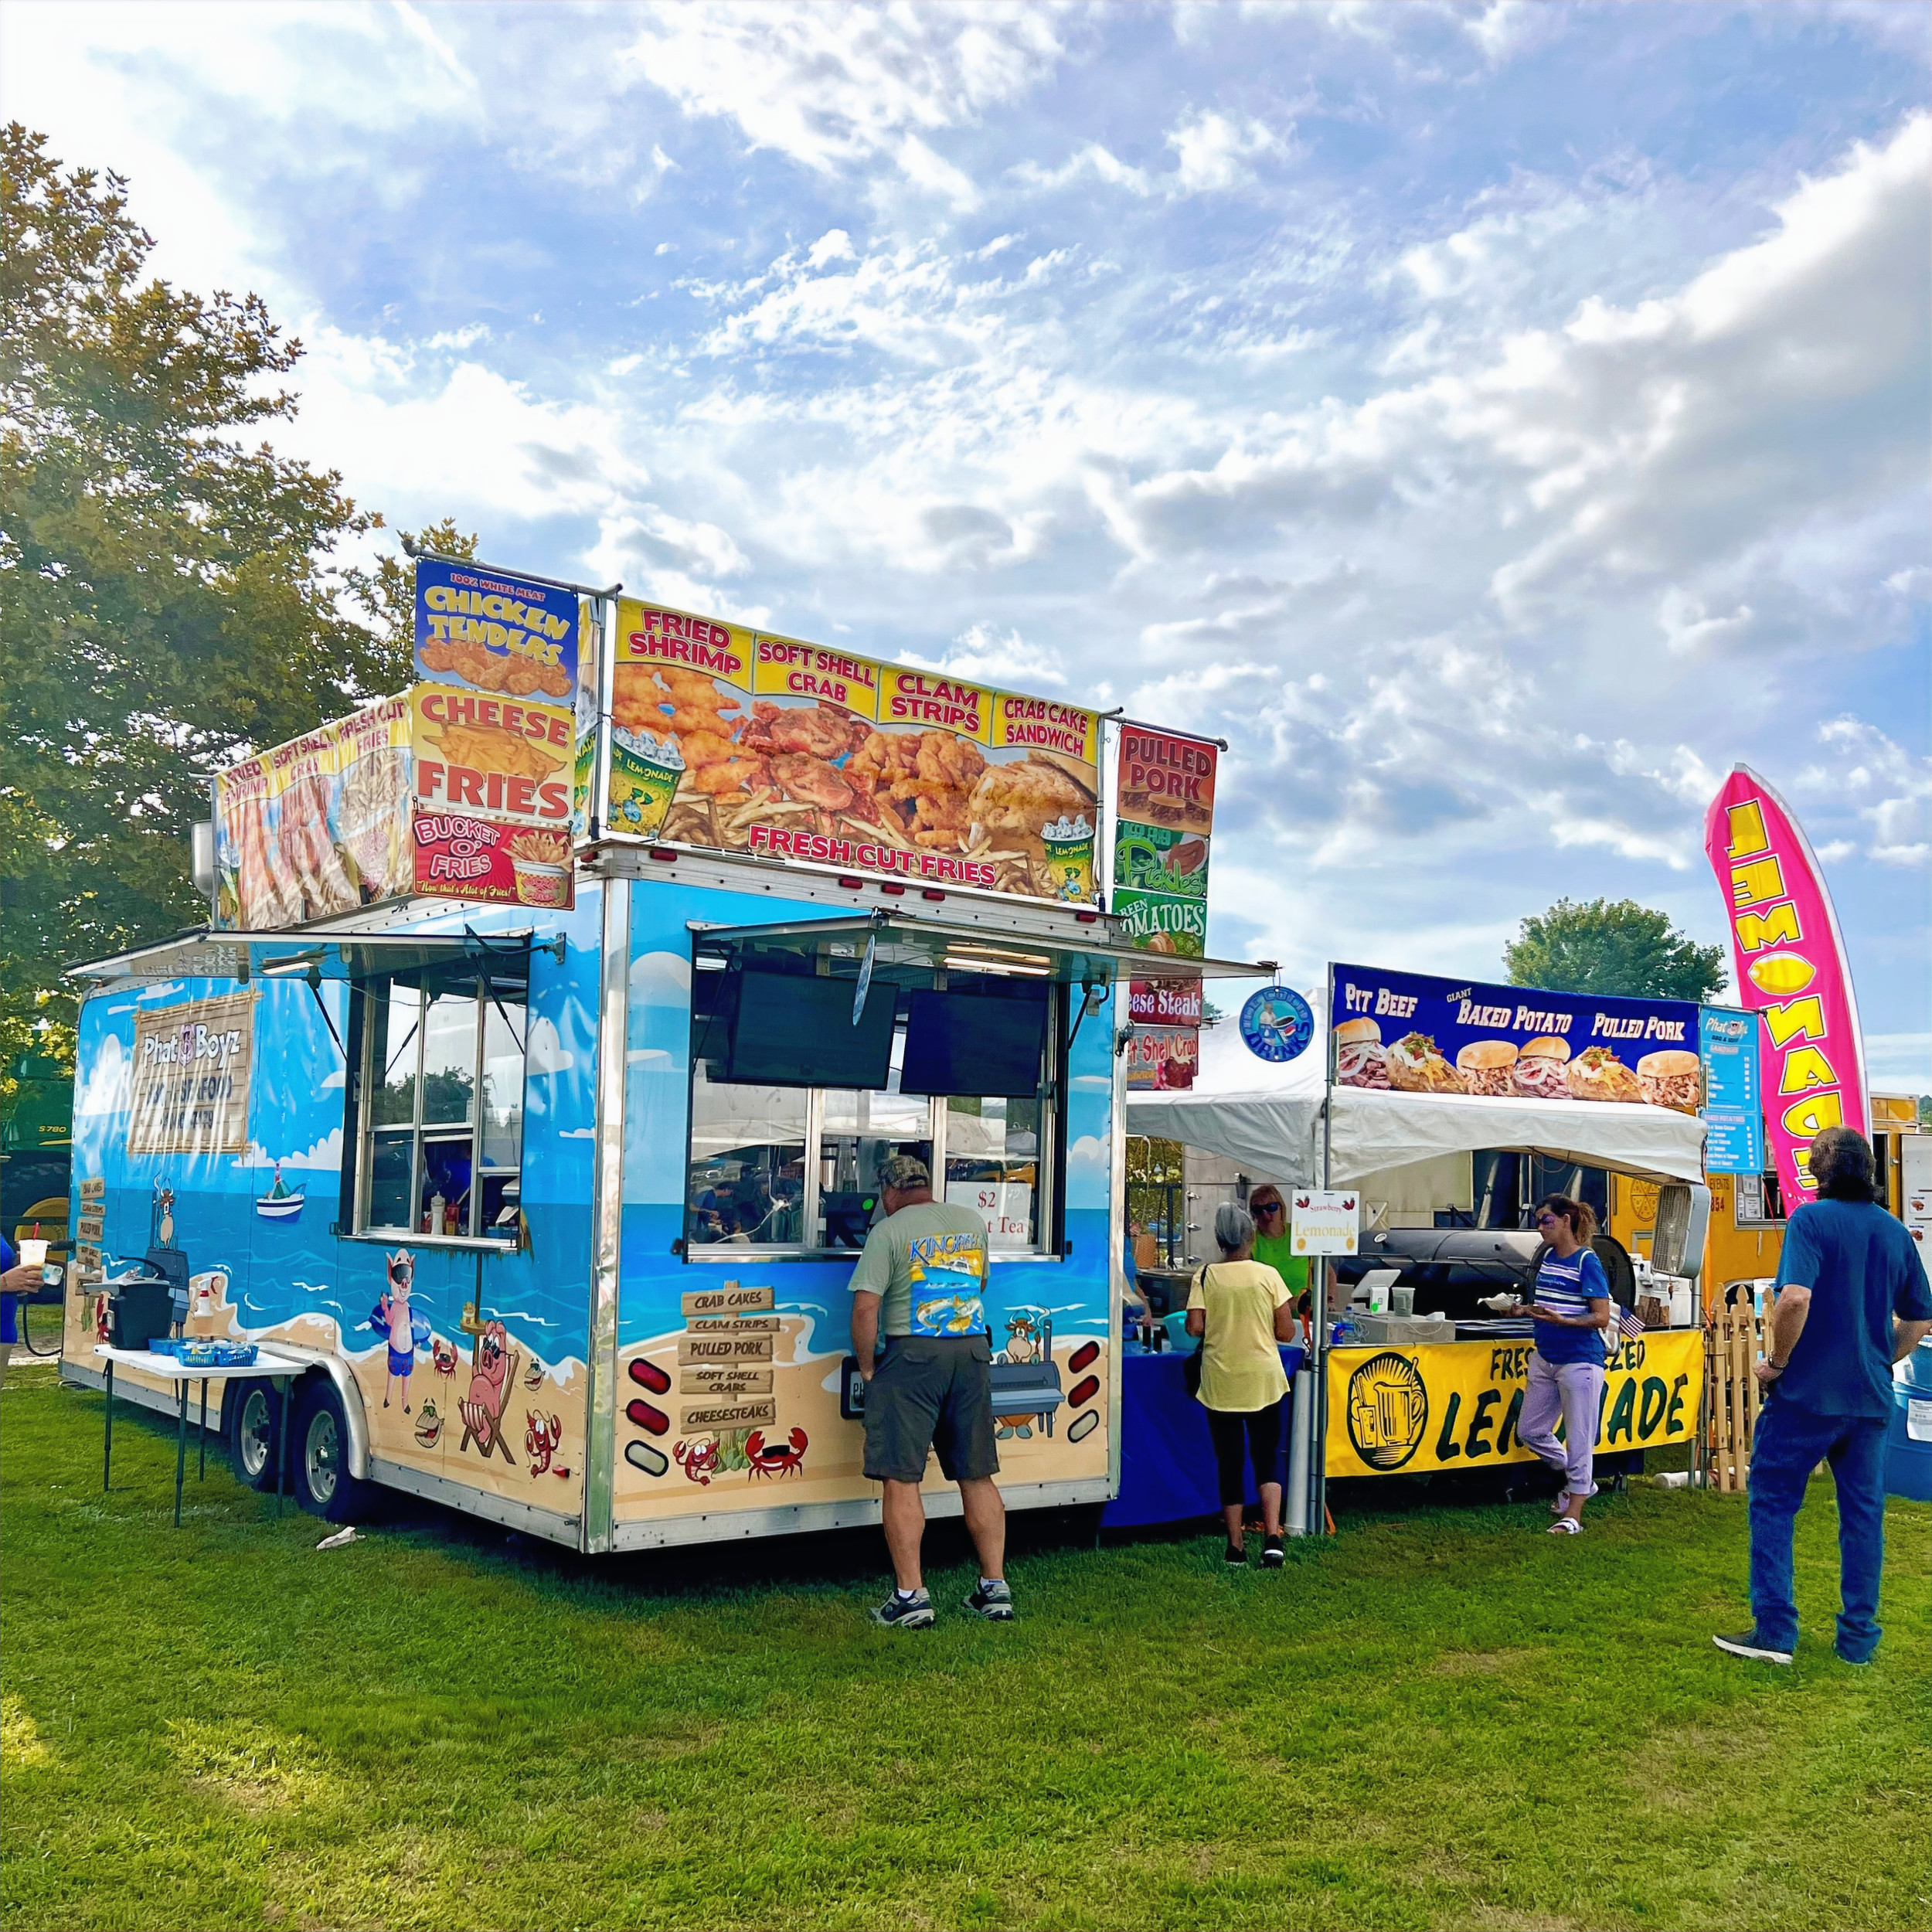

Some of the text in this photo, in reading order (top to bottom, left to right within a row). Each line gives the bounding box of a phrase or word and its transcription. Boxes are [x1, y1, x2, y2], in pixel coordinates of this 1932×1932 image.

[451, 573, 546, 602] 100% WHITE MEAT
[424, 585, 570, 640] CHICKEN
[427, 614, 563, 666] TENDERS
[641, 608, 731, 651] FRIED
[628, 631, 742, 676] SHRIMP
[757, 640, 877, 691] SOFT SHELL
[787, 672, 848, 704] CRAB
[895, 672, 980, 712] CLAM
[378, 701, 405, 722] CUT
[420, 694, 570, 750] CHEESE
[889, 695, 981, 735] STRIPS
[1002, 697, 1089, 738] CRAB CAKE
[357, 727, 389, 755] FRIES
[1004, 722, 1084, 759] SANDWICH
[274, 746, 300, 770] SOFT
[627, 758, 674, 783] LEMONADE
[1124, 735, 1213, 779] PULLED
[226, 760, 261, 787] FRIED
[1129, 761, 1202, 802] PORK
[418, 759, 570, 819] FRIES
[413, 816, 501, 847] BUCKET
[430, 854, 492, 879] FRIES
[748, 824, 996, 886] FRESH CUT FRIES
[1114, 835, 1203, 896] Pickles
[1114, 899, 1148, 917] REEN
[1121, 903, 1205, 937] OMATOES
[1158, 989, 1201, 1015] Steak
[1345, 982, 1419, 1019] PIT BEEF
[1446, 987, 1472, 1004] GIANT
[1456, 998, 1573, 1035] BAKED POTATO
[1590, 1012, 1686, 1042] PULLED PORK
[1705, 1017, 1728, 1033] Phat
[144, 1023, 242, 1070] Phat Boyz
[1141, 1033, 1172, 1063] Shell
[1174, 1032, 1198, 1058] Crab
[978, 1189, 996, 1210] $2
[1709, 1178, 1730, 1191] EVENTS
[1310, 1202, 1342, 1215] Strawberry
[998, 1216, 1024, 1234] Tea
[1294, 1221, 1355, 1237] Lemonade
[694, 1291, 762, 1309] CRAB CAKES
[695, 1319, 769, 1329] CLAM STRIPS
[690, 1341, 764, 1356] PULLED PORK
[696, 1371, 760, 1381] SOFT SHELL
[1490, 1346, 1535, 1382] FRES
[709, 1383, 747, 1392] CRABS
[687, 1405, 769, 1424] CHEESESTEAKS
